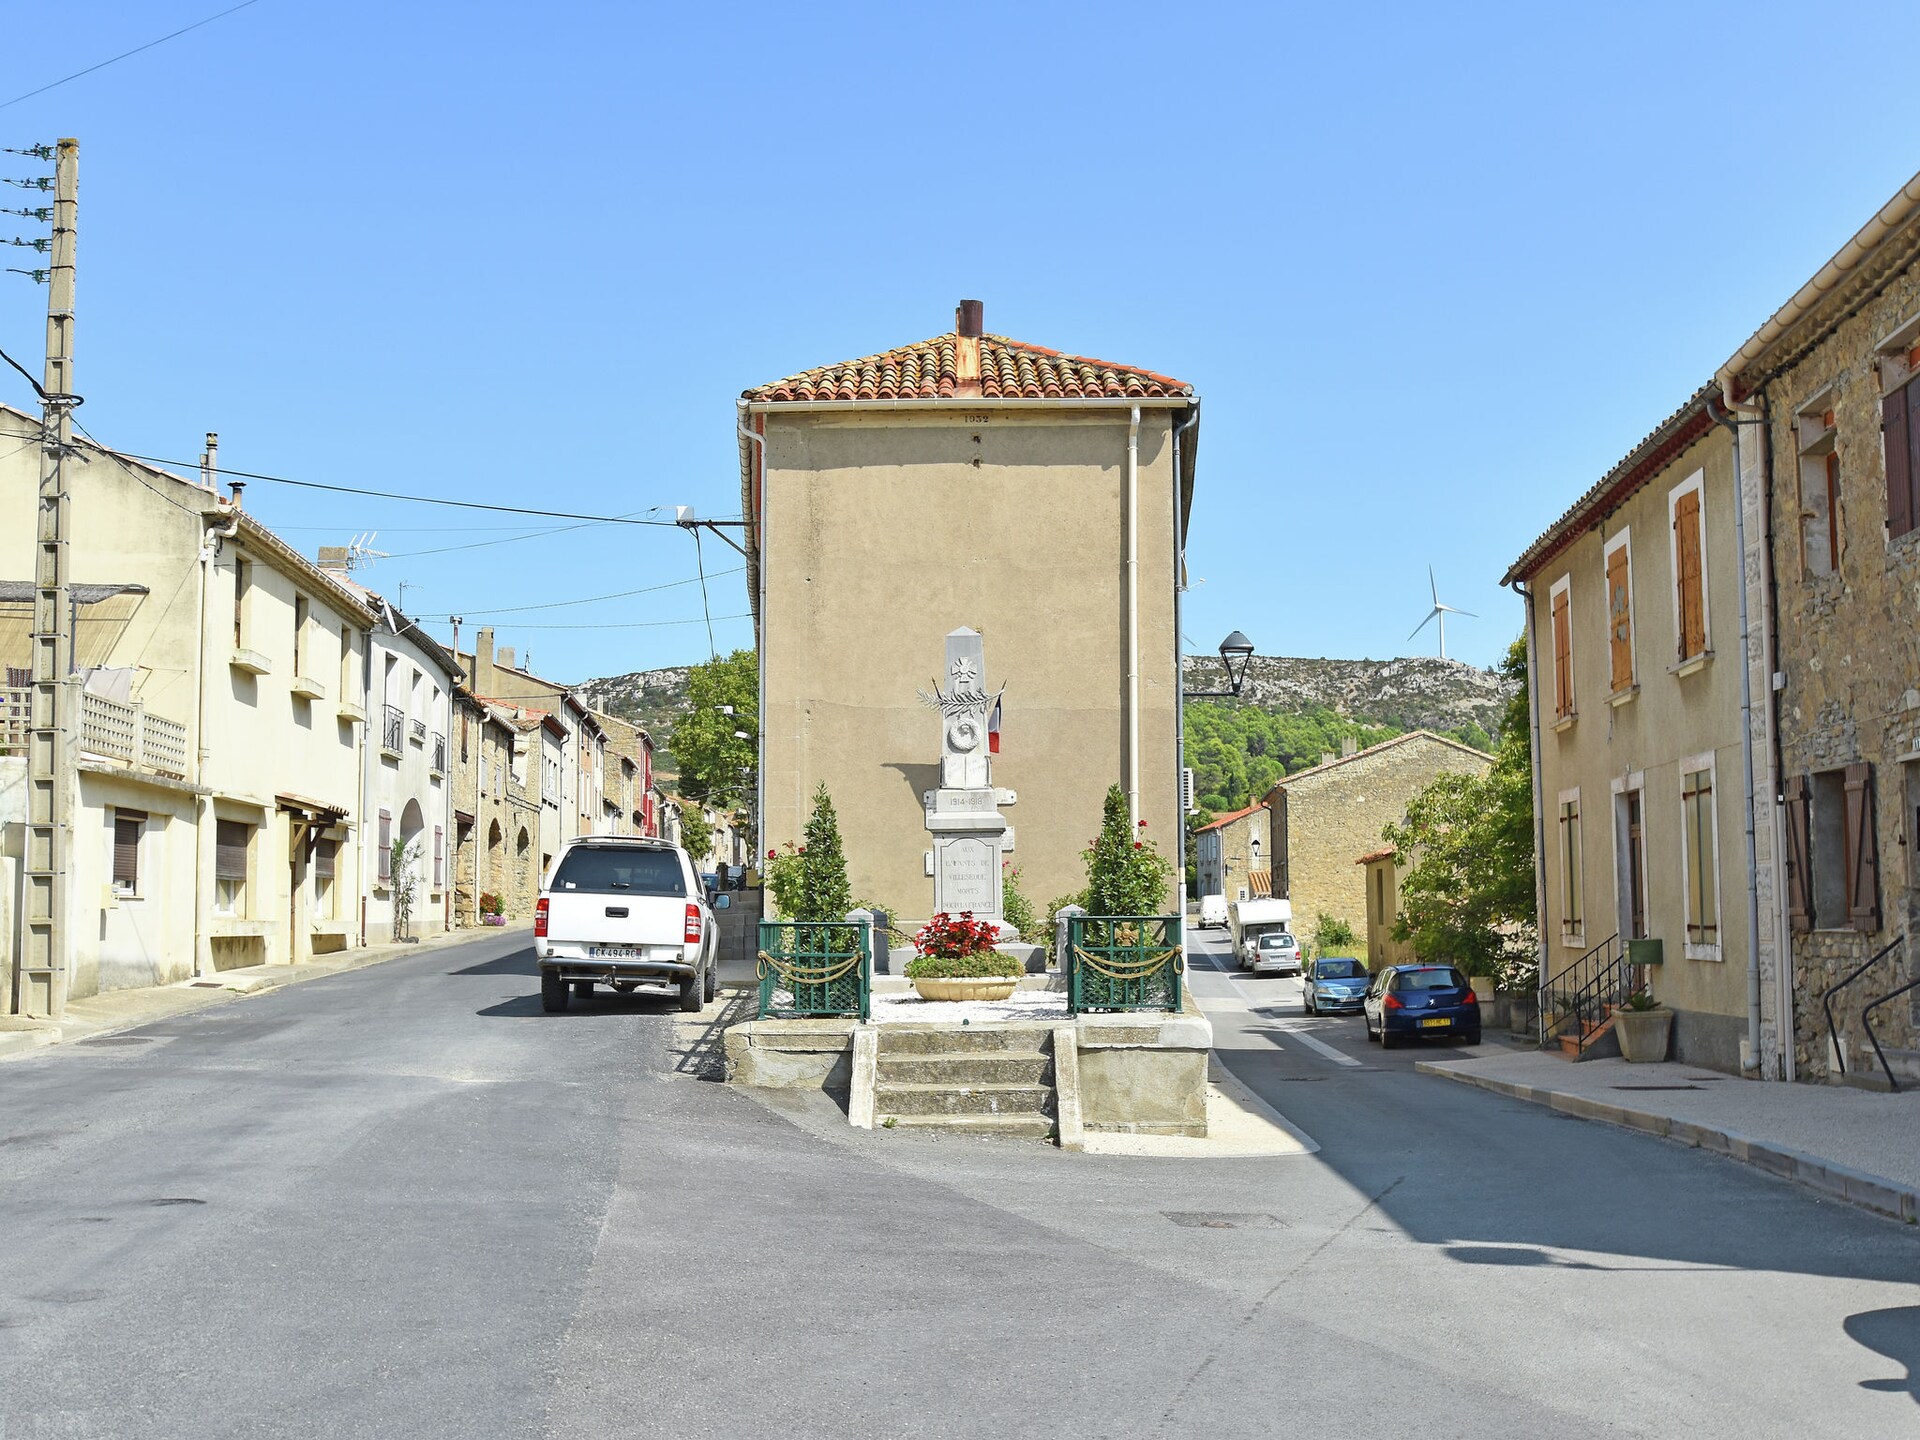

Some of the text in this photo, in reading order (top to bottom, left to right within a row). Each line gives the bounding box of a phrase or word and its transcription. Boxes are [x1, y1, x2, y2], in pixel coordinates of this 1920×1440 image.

[964, 415, 989, 423] 1932
[950, 797, 983, 806] 1914-1918
[957, 887, 980, 895] MORTS
